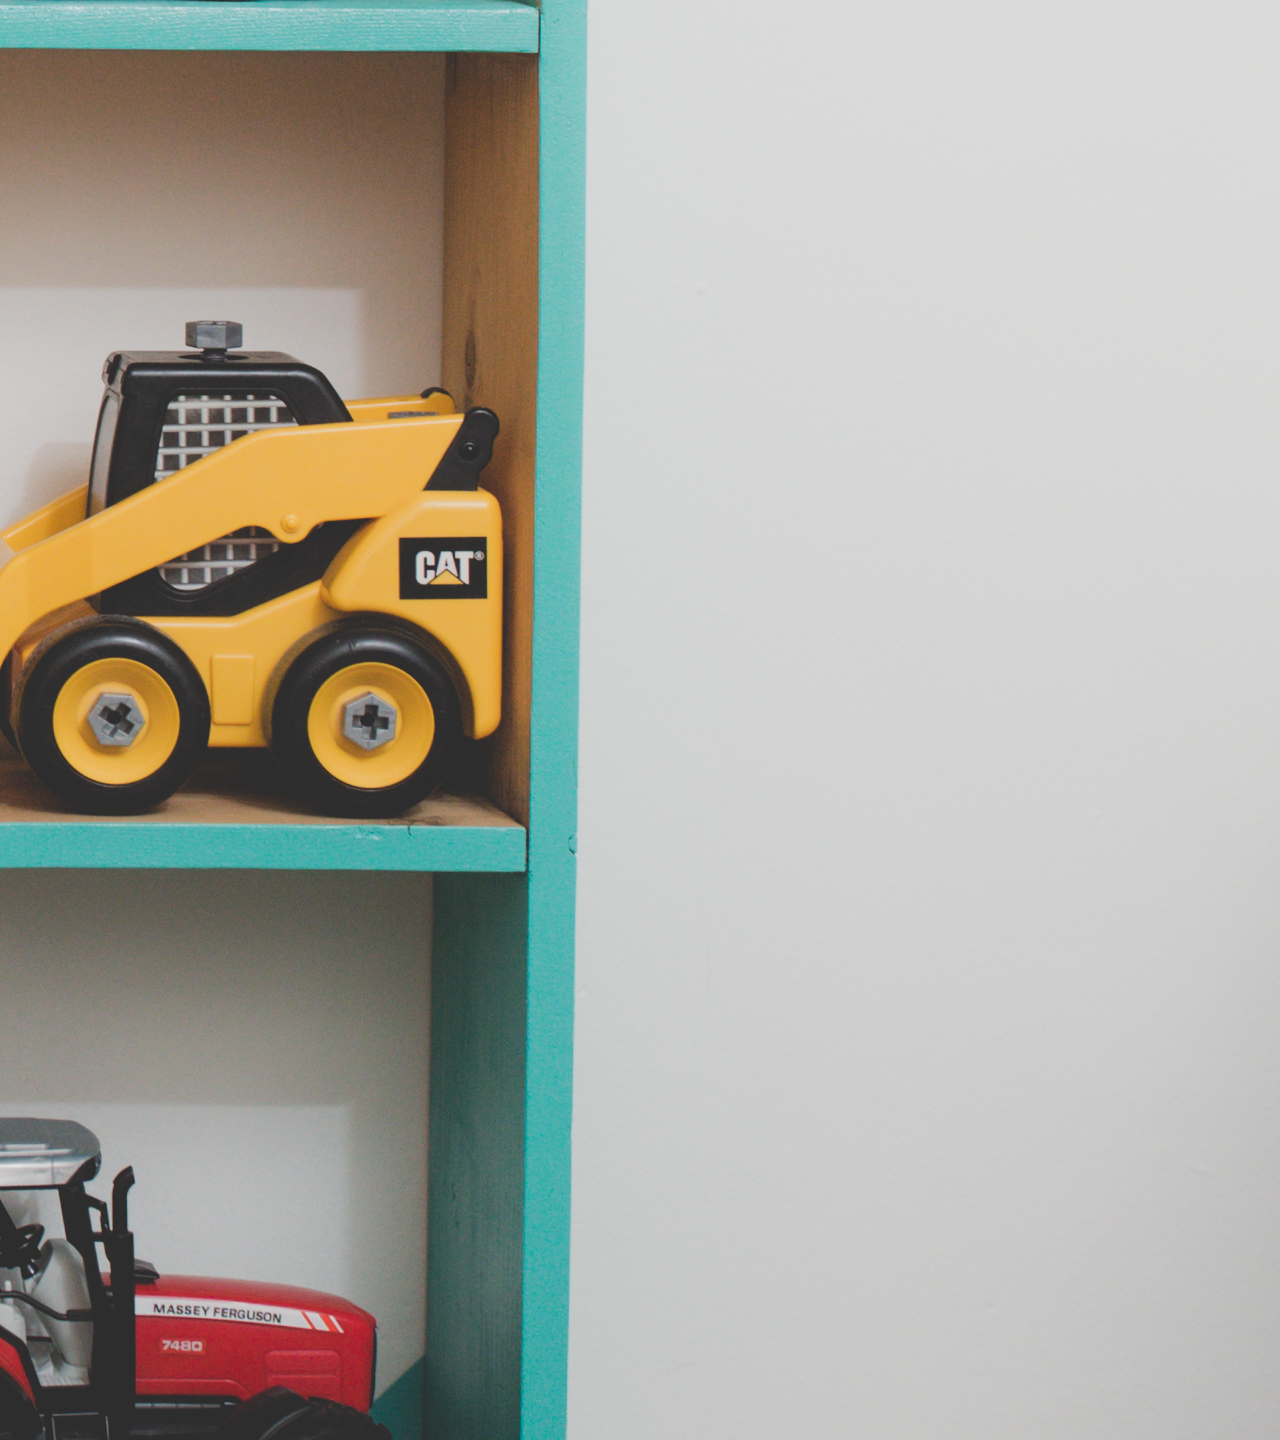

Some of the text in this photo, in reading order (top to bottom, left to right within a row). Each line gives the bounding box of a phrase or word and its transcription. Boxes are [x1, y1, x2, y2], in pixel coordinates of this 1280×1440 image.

[153, 1303, 282, 1324] MASSEY FERGUSON
[161, 1339, 203, 1352] 7480
